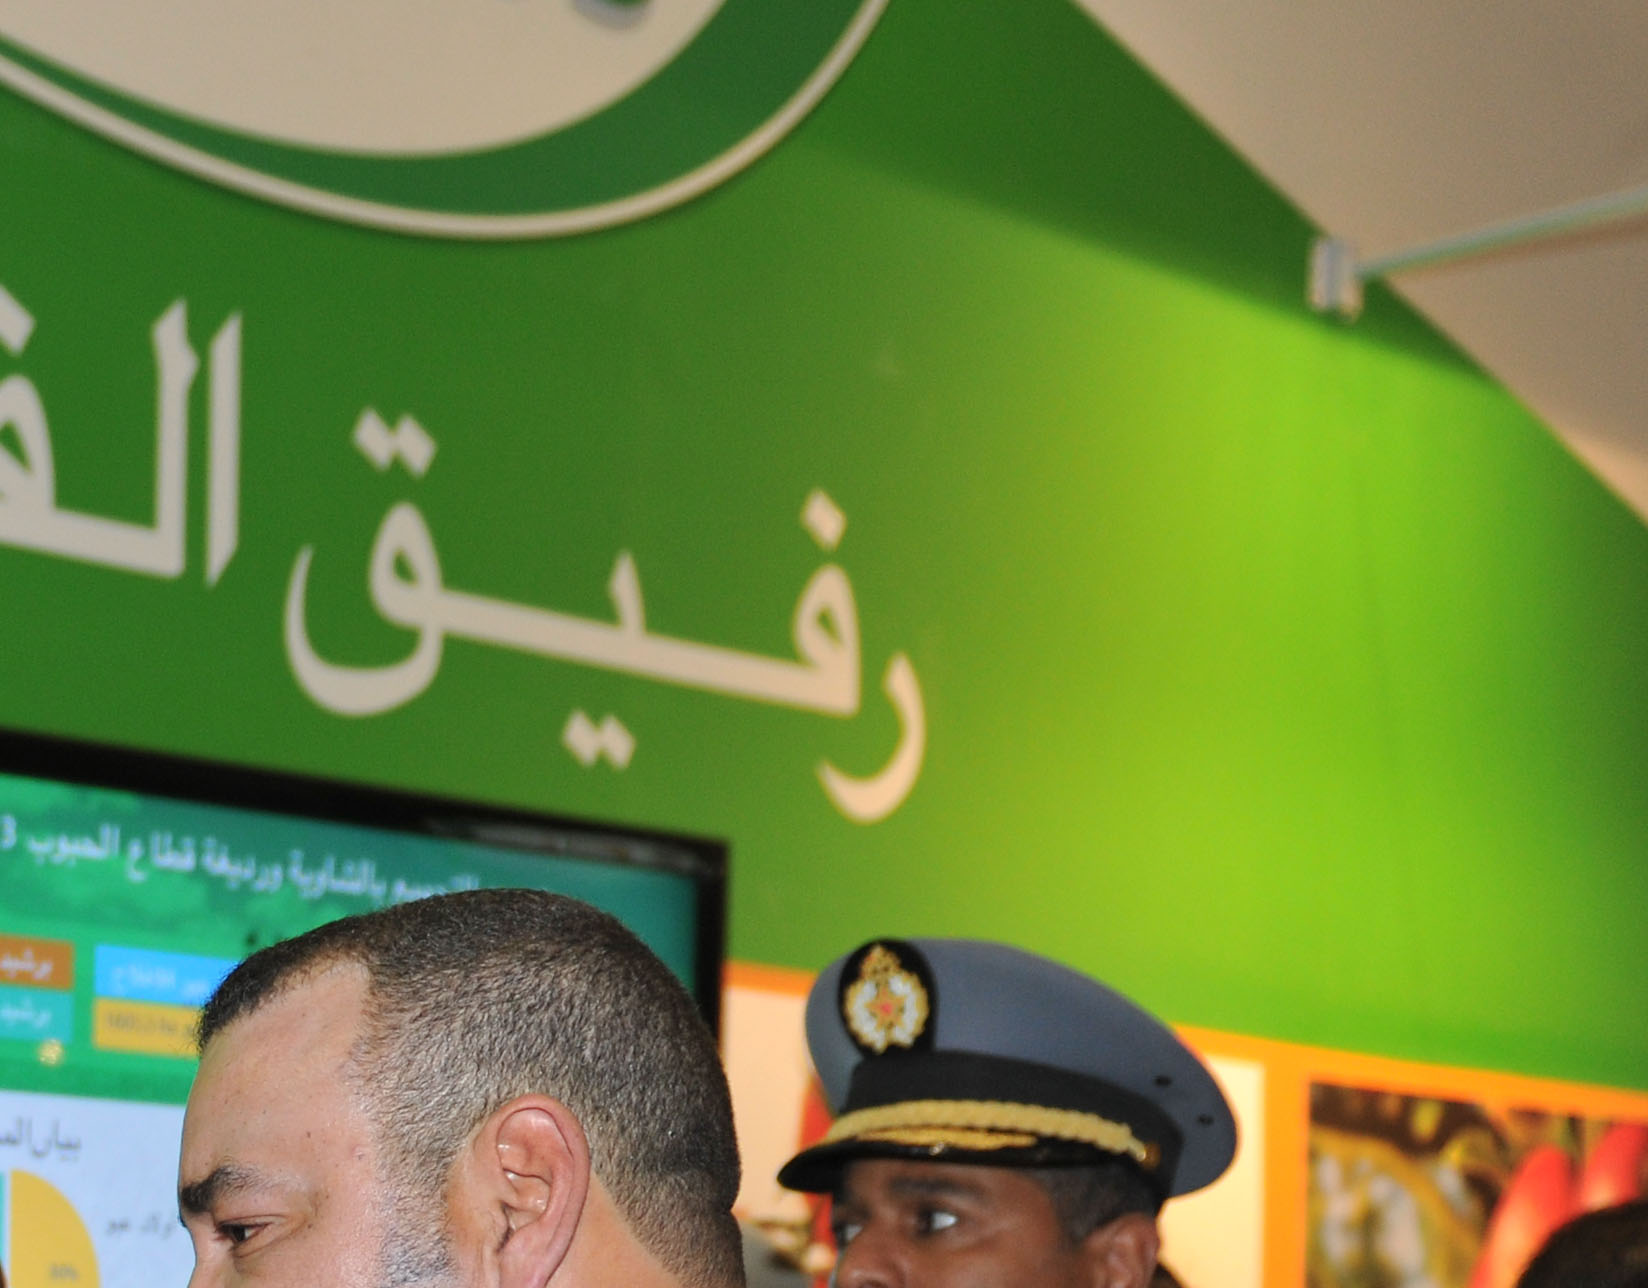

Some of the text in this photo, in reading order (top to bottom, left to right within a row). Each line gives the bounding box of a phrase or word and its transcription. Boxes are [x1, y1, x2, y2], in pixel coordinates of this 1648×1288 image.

[284, 408, 926, 821] رفيق
[25, 822, 122, 866] الحبوب
[127, 829, 198, 883] قطاع
